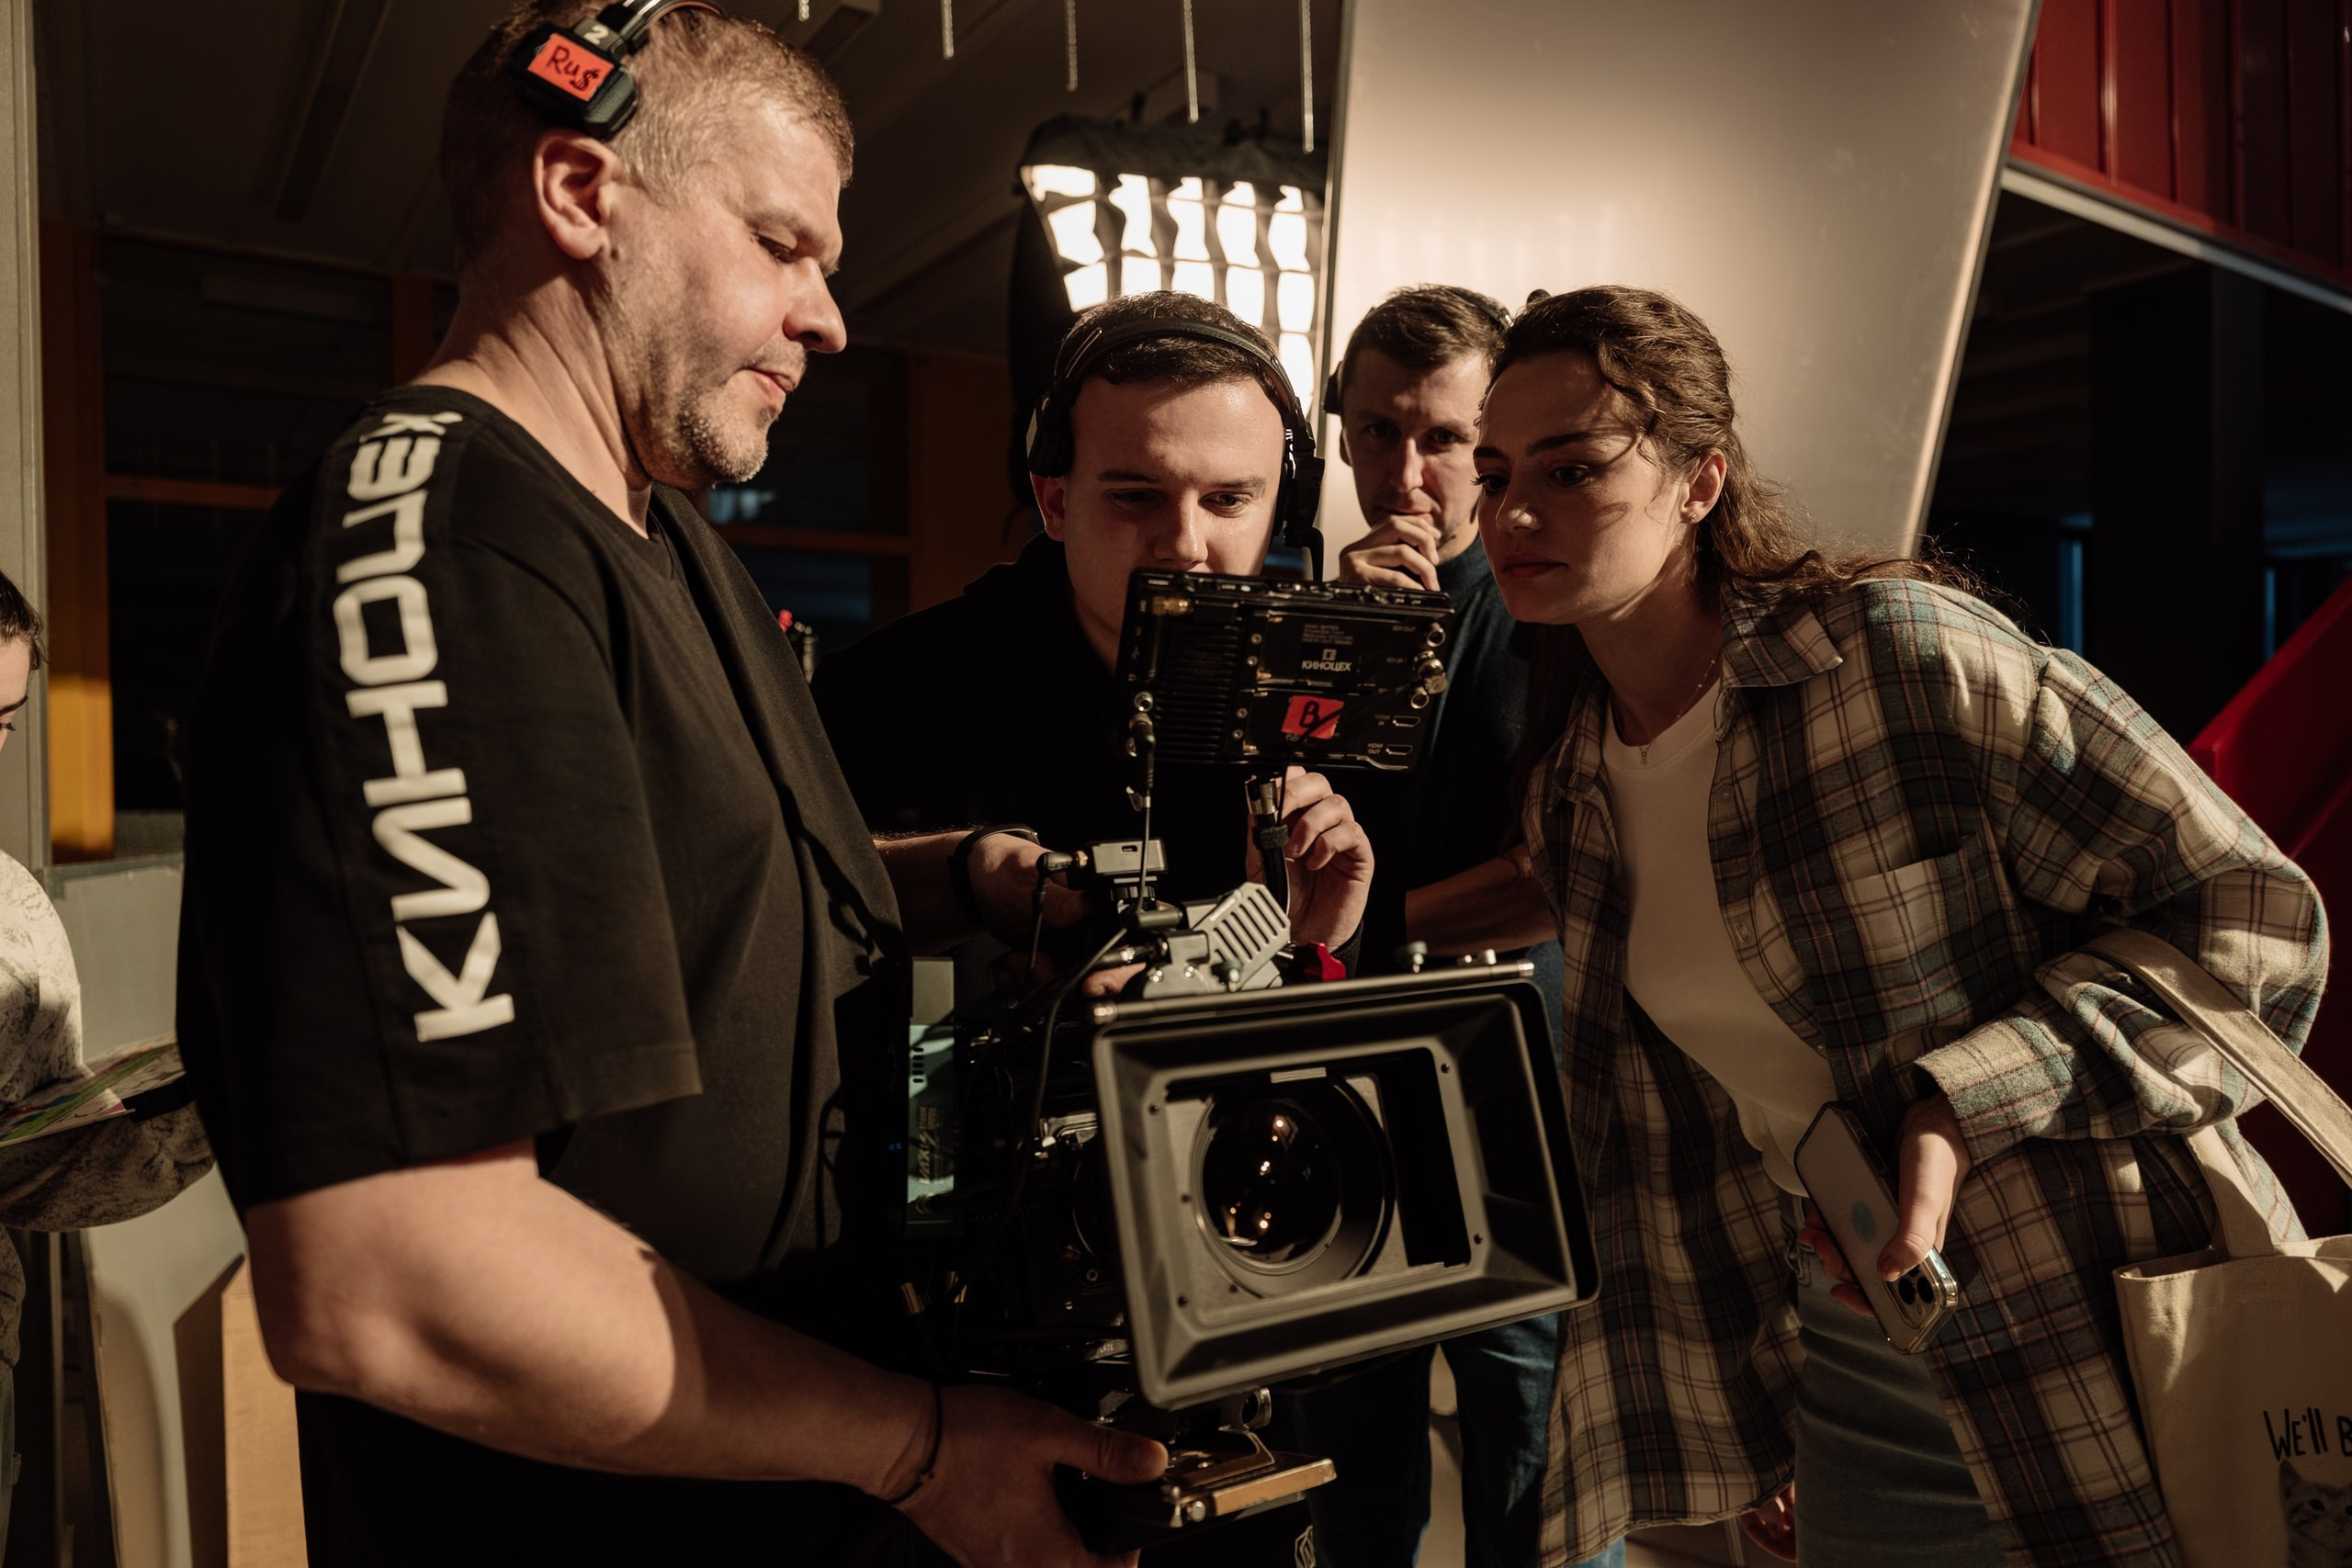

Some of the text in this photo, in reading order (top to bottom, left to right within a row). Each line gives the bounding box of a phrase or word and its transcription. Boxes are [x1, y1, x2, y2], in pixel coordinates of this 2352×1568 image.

[582, 25, 609, 45] 2
[1301, 660, 1352, 672] КИНОЦЕХ
[333, 412, 514, 1042] КИНОЦЕХ
